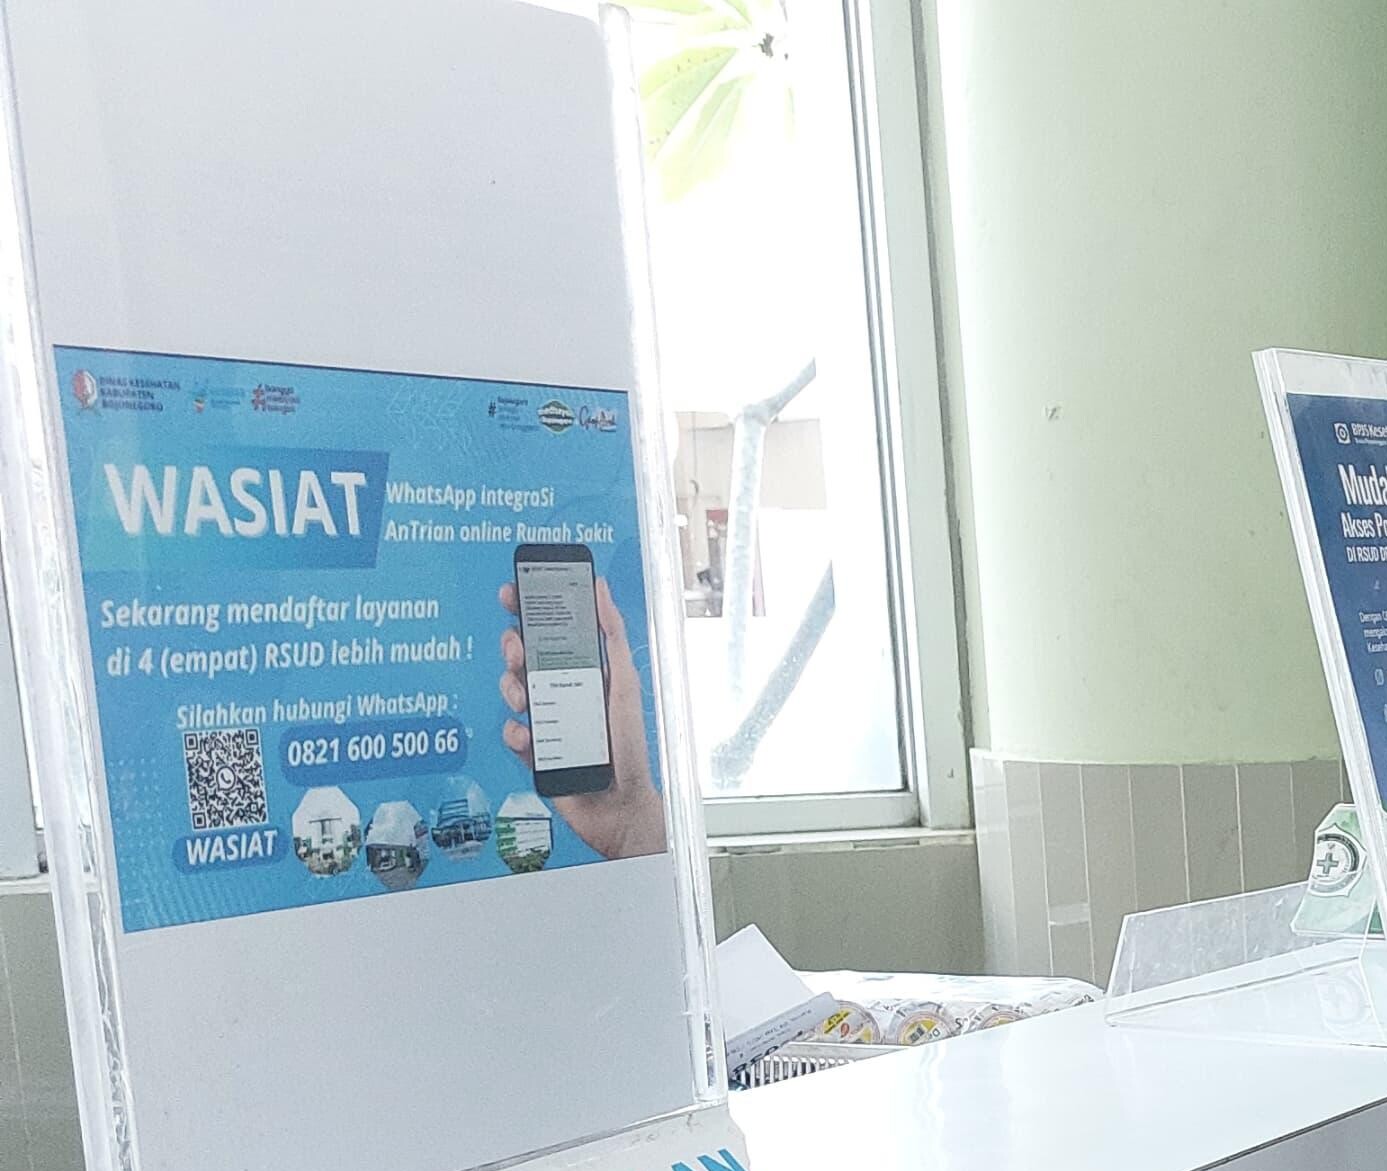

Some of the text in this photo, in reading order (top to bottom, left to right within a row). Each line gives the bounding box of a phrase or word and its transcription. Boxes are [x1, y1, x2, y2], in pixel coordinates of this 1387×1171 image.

[103, 463, 367, 536] WASIAT
[386, 481, 554, 513] WhatsApp integraSi
[384, 519, 614, 543] AnTrian online Rumah Sakit
[1341, 512, 1375, 538] Akses
[1357, 546, 1380, 562] RSUD
[101, 594, 439, 632] Sekarang mendaftar layanan
[107, 647, 130, 676] di
[138, 648, 153, 675] 4
[160, 643, 257, 680] (empat)
[264, 642, 325, 668] RSUD
[331, 638, 384, 665] lebih
[389, 635, 461, 662] mudah
[176, 703, 266, 729] Silahkan
[273, 696, 353, 724] hubungi
[357, 691, 448, 716] WhatsApp
[287, 728, 459, 767] 0821 600 500 66
[186, 830, 278, 866] WASIAT
